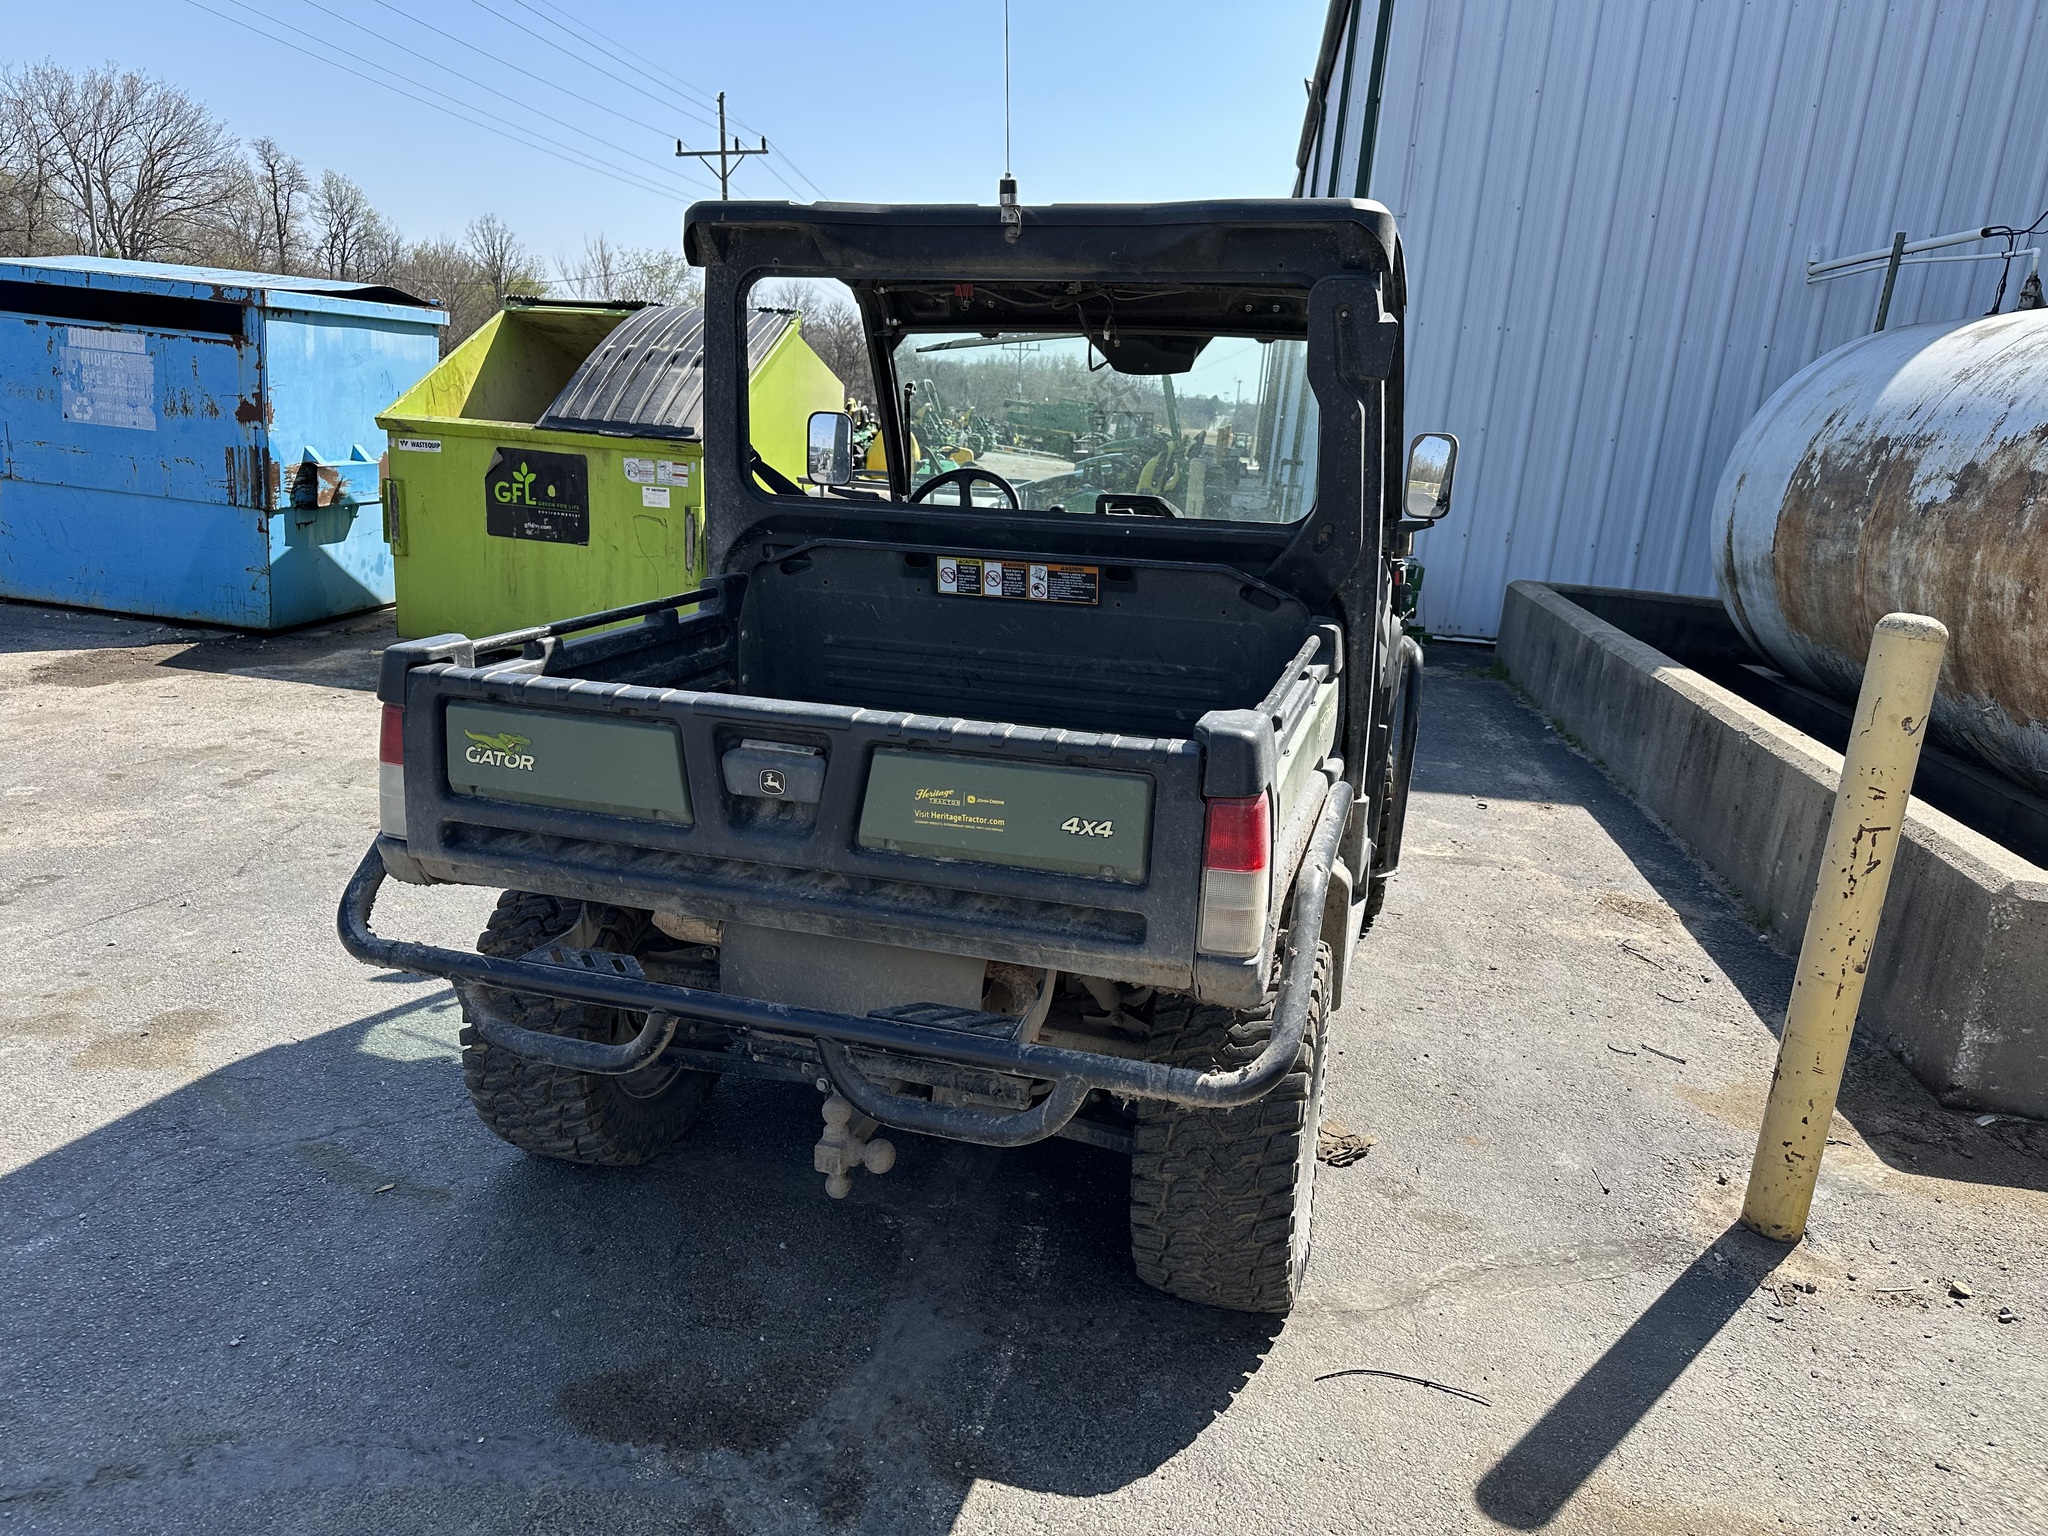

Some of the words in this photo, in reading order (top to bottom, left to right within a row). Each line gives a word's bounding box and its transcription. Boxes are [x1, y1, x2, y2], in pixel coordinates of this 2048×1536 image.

[411, 441, 441, 449] WASTEQUIP
[494, 474, 537, 506] GFL
[557, 502, 568, 510] FOR
[538, 510, 581, 518] environmental
[465, 746, 535, 771] GATOR
[914, 788, 955, 800] Heritage
[929, 797, 960, 806] TRACTOR
[914, 809, 929, 818] Visit
[931, 811, 1005, 826] HeritageTractor.com
